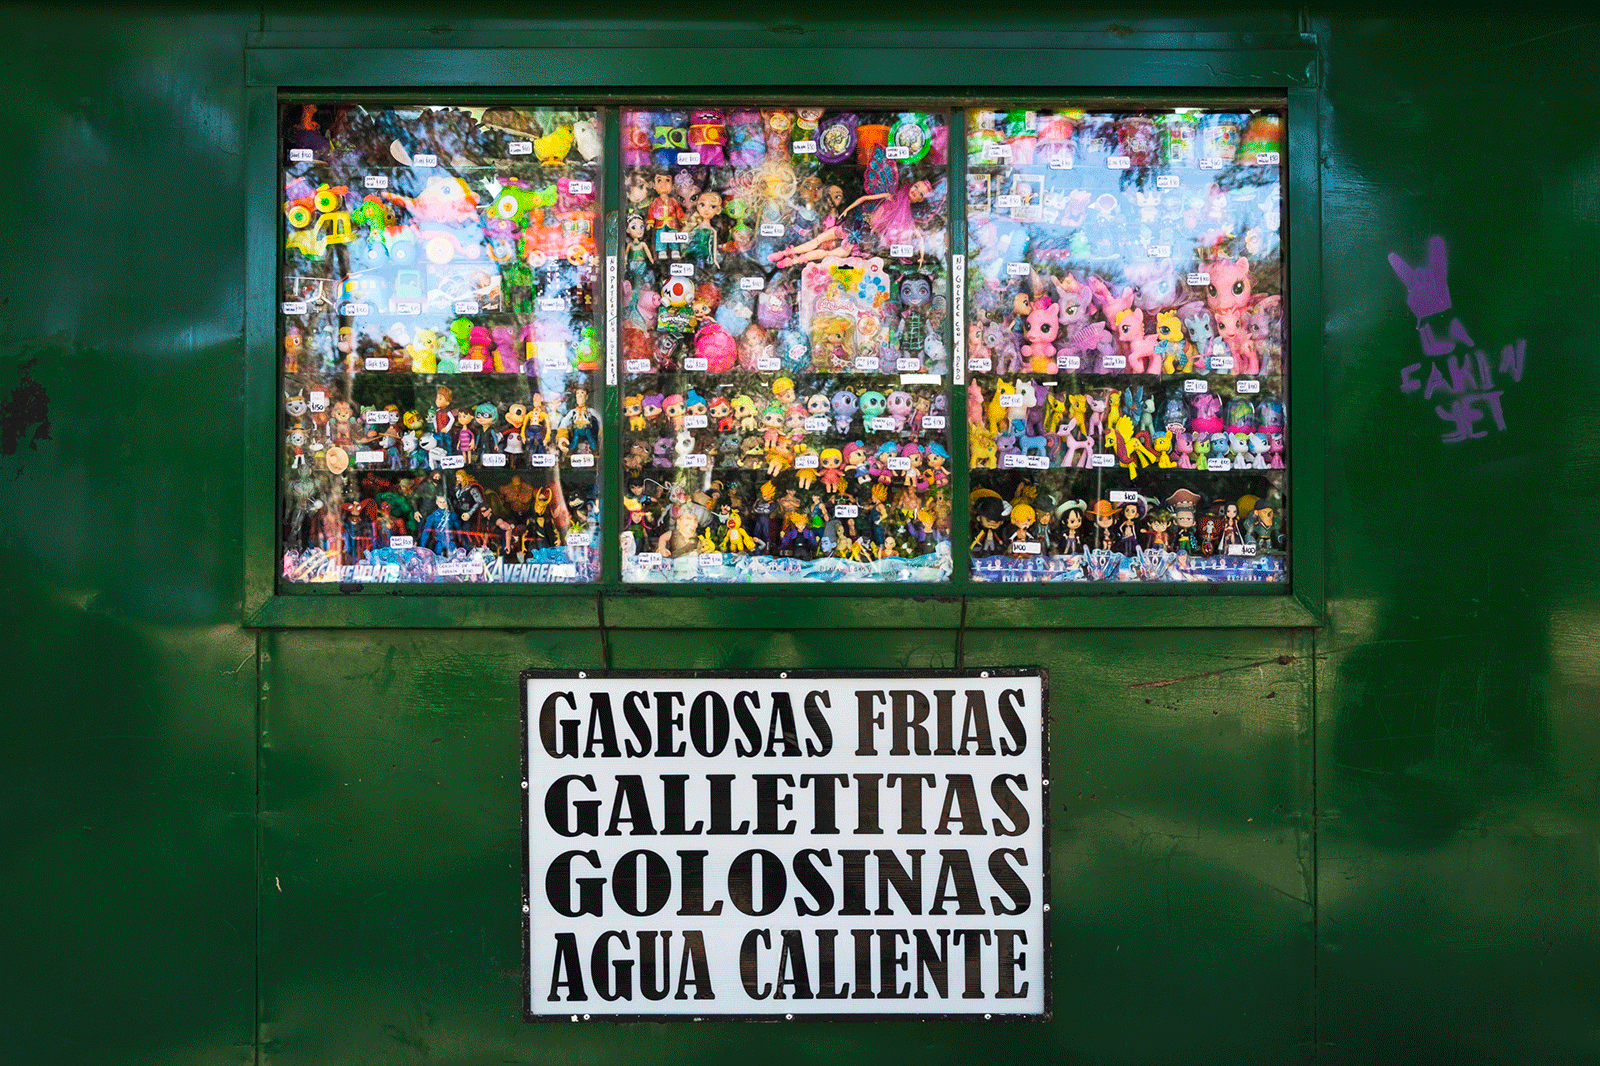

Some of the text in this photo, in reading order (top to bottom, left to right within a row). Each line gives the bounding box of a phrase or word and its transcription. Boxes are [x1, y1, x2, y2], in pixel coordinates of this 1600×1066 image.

[311, 402, 324, 411] $150
[538, 688, 1027, 758] GASEOSAS FRIAS
[544, 773, 1030, 837] GALLETITAS
[545, 848, 1031, 917] GOLOSINAS
[547, 928, 1029, 1002] AGUA CALIENTE
